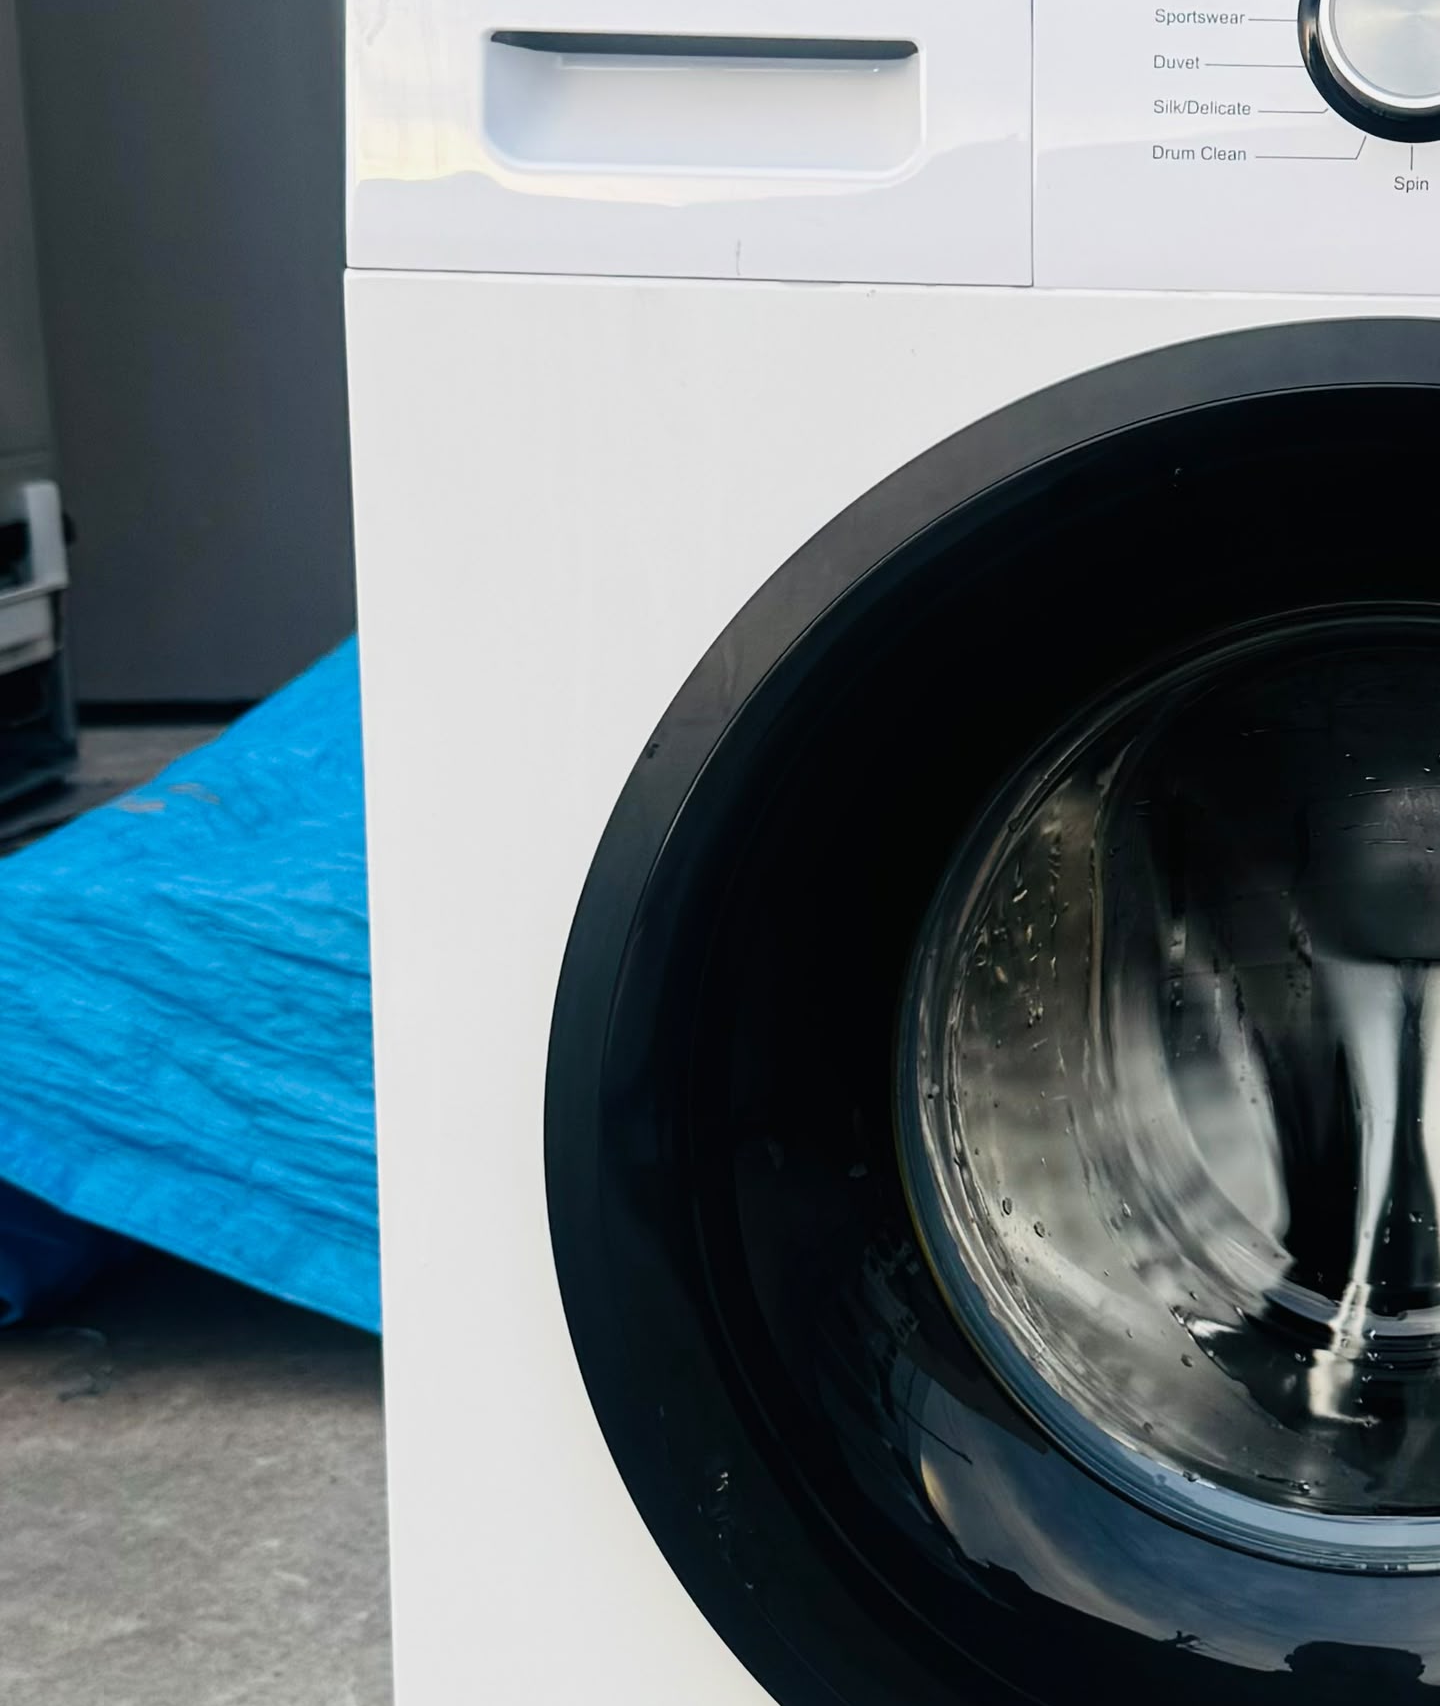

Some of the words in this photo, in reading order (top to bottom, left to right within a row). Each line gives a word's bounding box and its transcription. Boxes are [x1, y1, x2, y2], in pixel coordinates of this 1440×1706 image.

[1154, 9, 1246, 29] Sportswear
[1153, 55, 1200, 70] Duvet
[1153, 100, 1252, 116] Silk/Delicate
[1152, 146, 1196, 161] Drum
[1200, 146, 1247, 162] Clean
[1394, 176, 1430, 194] Spin
